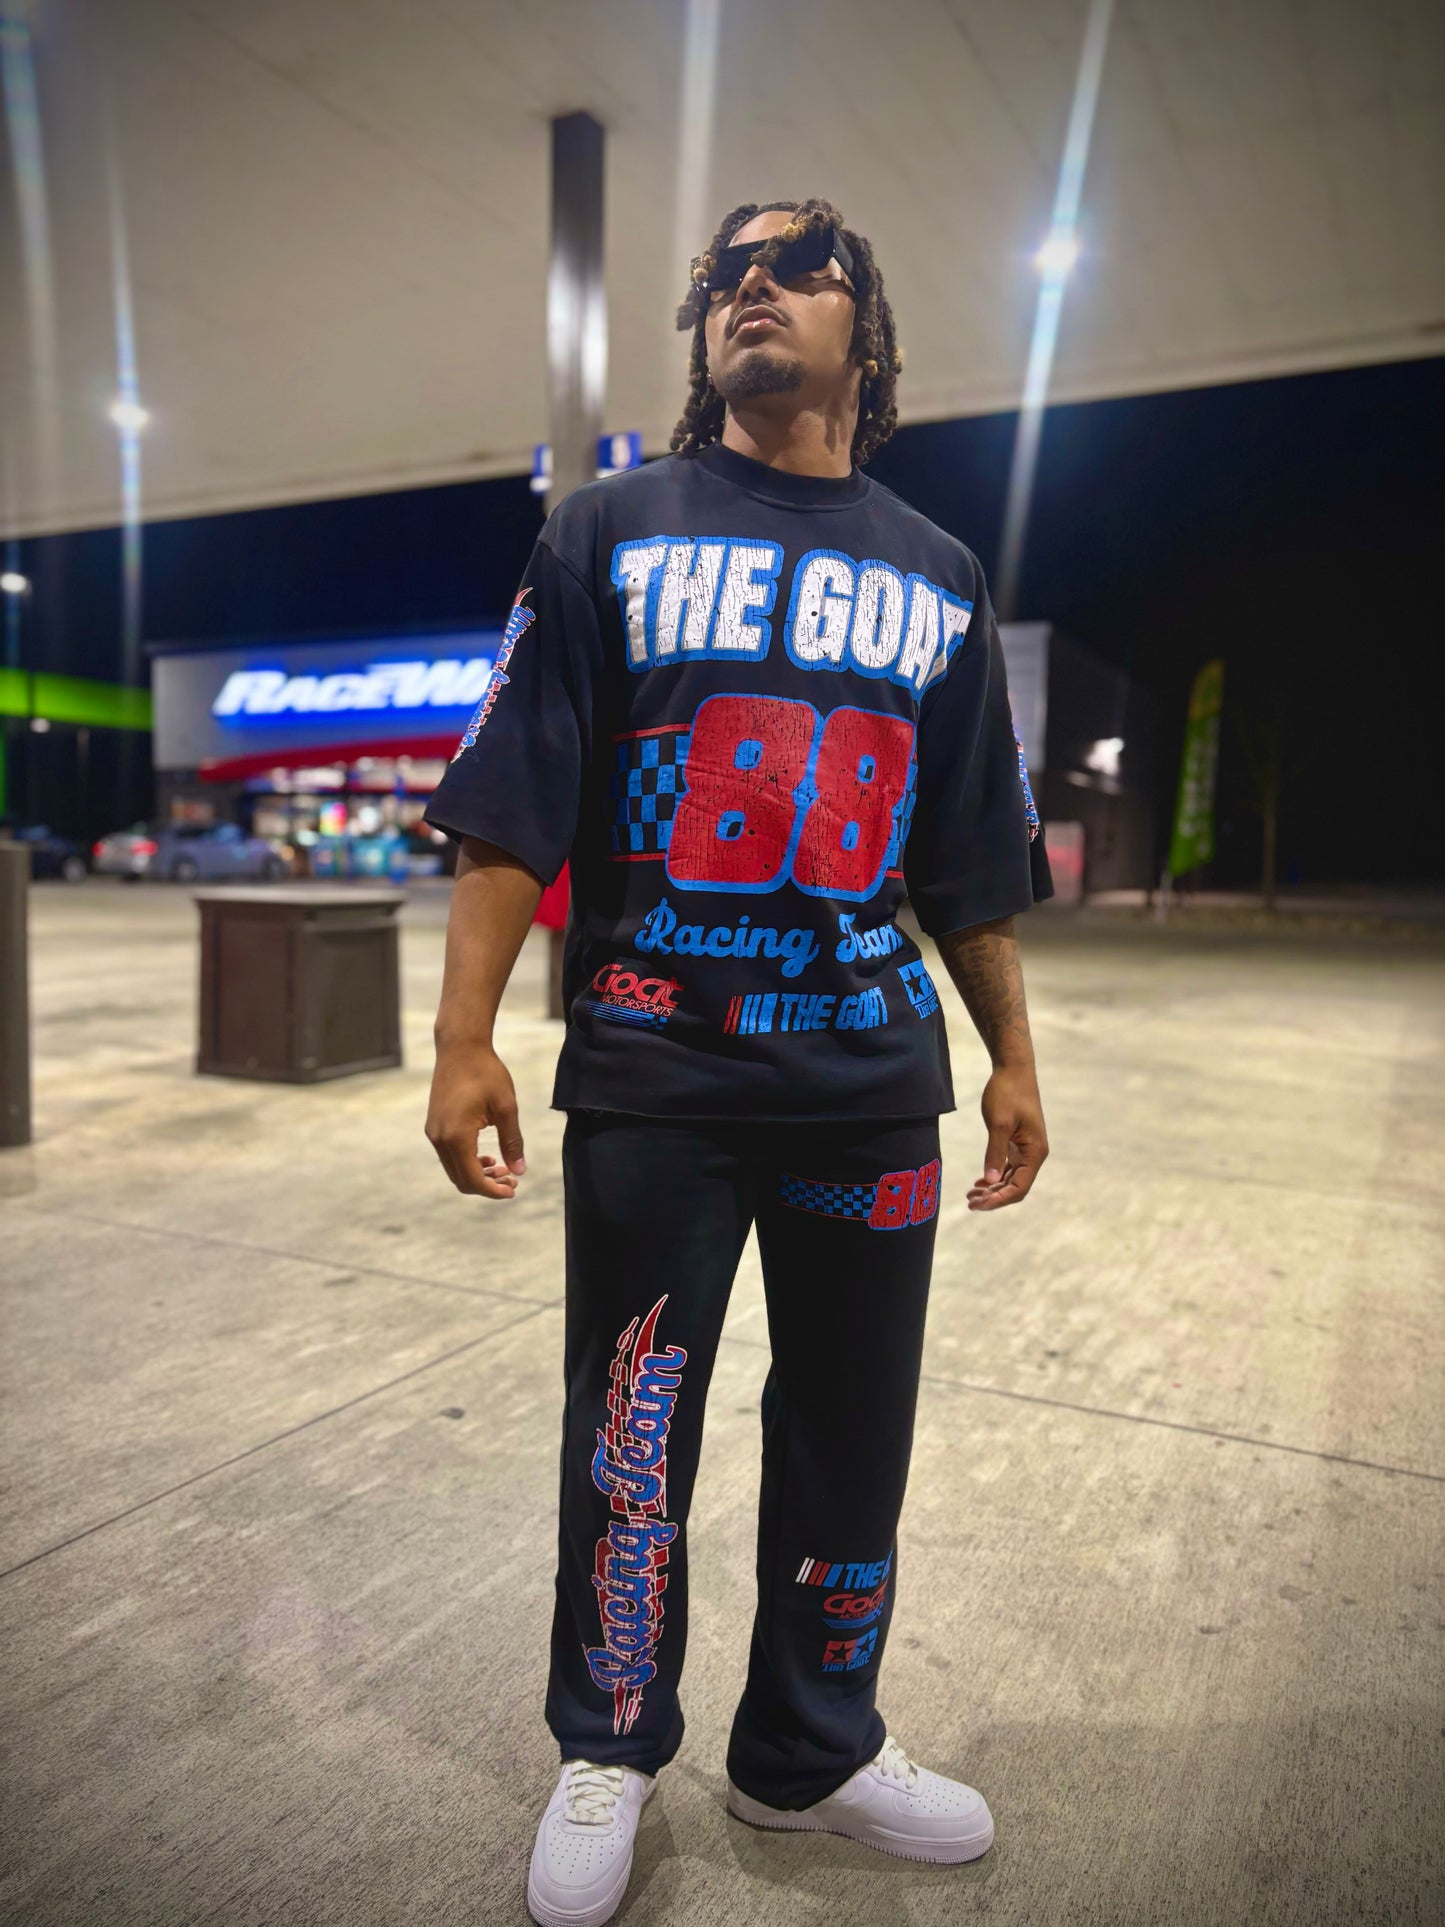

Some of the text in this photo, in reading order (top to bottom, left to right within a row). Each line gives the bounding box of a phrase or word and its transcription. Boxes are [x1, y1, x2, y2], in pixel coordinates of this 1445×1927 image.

[612, 537, 974, 699] THE GOAT
[665, 693, 918, 903] 88
[634, 897, 821, 978] Racing
[601, 994, 674, 1017] MOTORSPORTS
[780, 993, 837, 1032] THE
[835, 986, 888, 1031] GOAT
[868, 1158, 941, 1231] 88
[582, 1345, 687, 1690] Racing Team
[844, 1559, 887, 1589] THE
